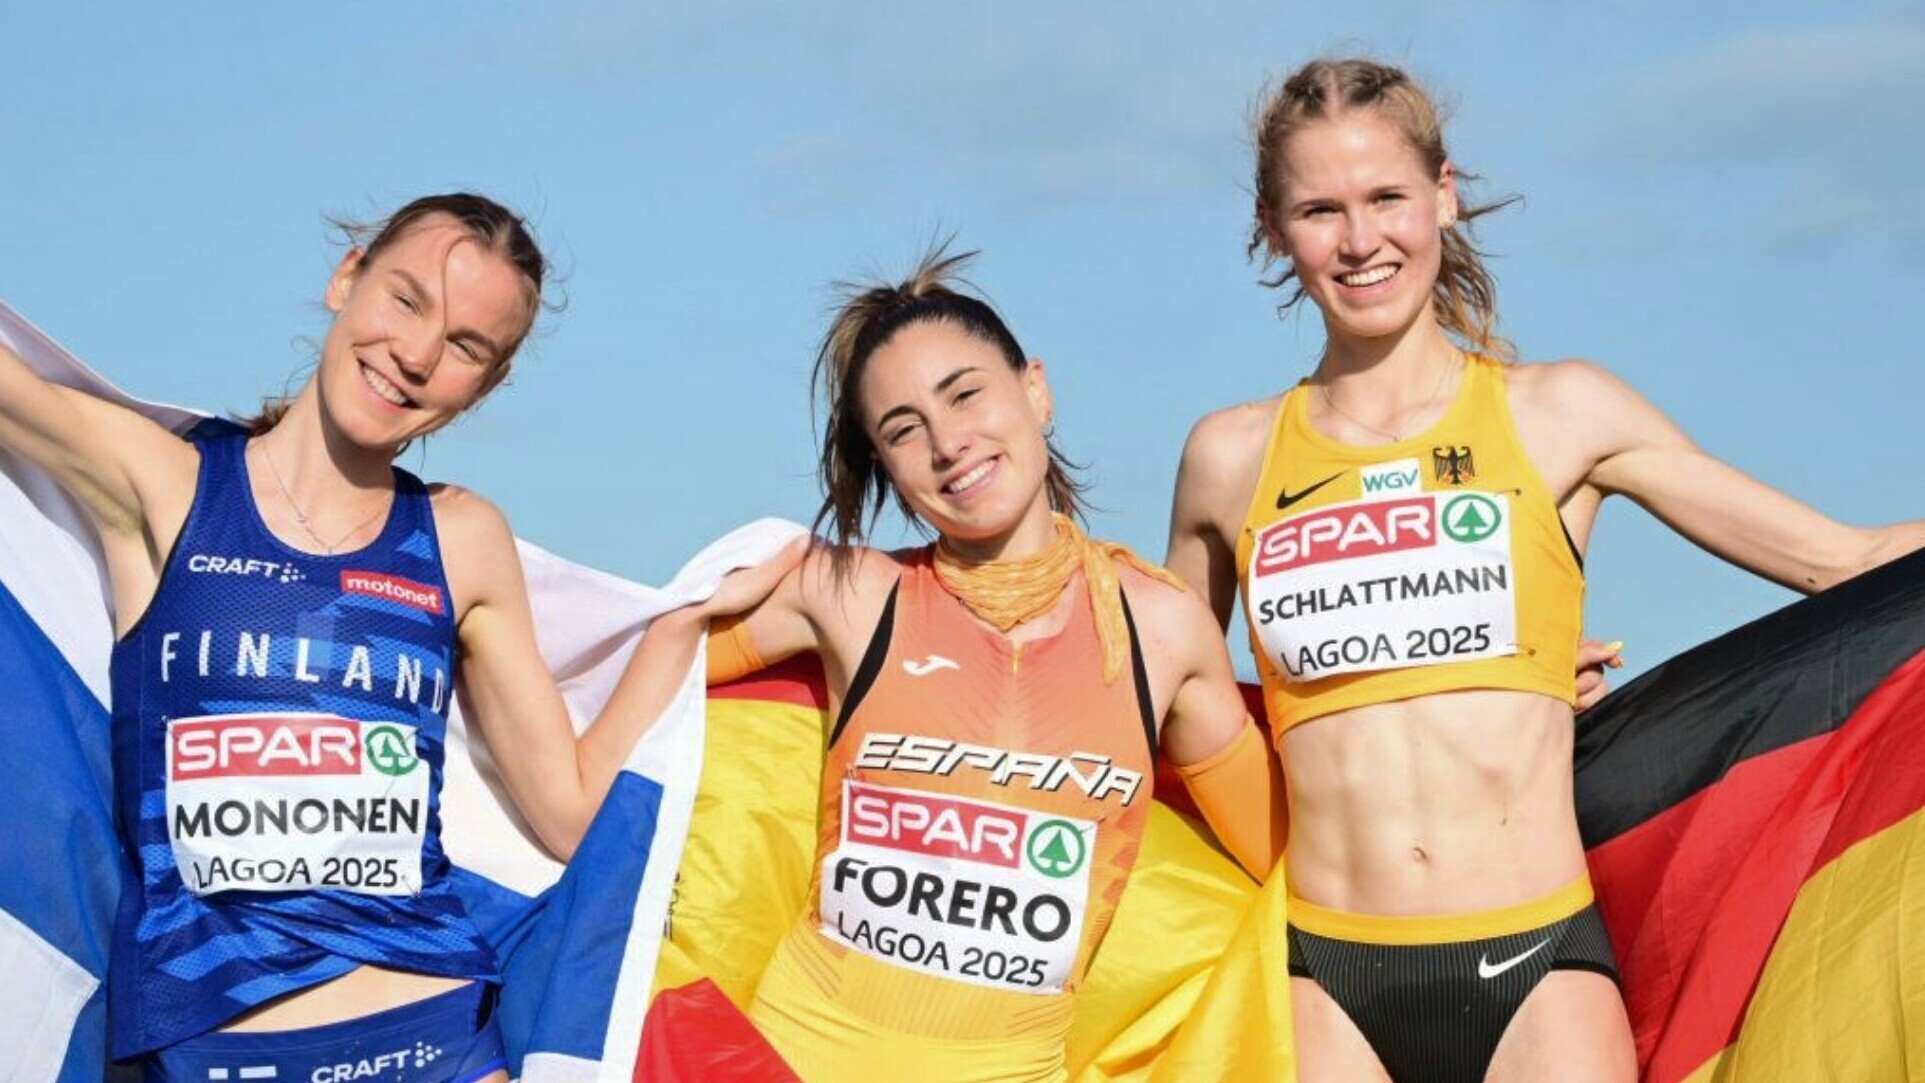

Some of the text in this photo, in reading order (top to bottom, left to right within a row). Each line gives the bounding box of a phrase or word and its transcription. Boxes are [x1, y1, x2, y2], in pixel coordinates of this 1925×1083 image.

[1362, 469, 1418, 492] WGV
[1260, 505, 1431, 567] SPAR
[188, 555, 279, 578] CRAFT
[347, 576, 438, 608] motonet
[1259, 564, 1507, 625] SCHLATTMANN
[161, 630, 445, 714] FINLAND
[1281, 623, 1491, 676] LAGOA 2025
[177, 726, 356, 771] SPAR
[855, 732, 1143, 807] ESPAÑA
[175, 798, 419, 839] MONONEN
[853, 796, 1018, 859] SPAR
[194, 856, 398, 888] LAGOA 2025
[833, 857, 1071, 942] FORERO
[837, 911, 1048, 987] LAGOA 2025
[312, 1048, 411, 1083] CRAFT
